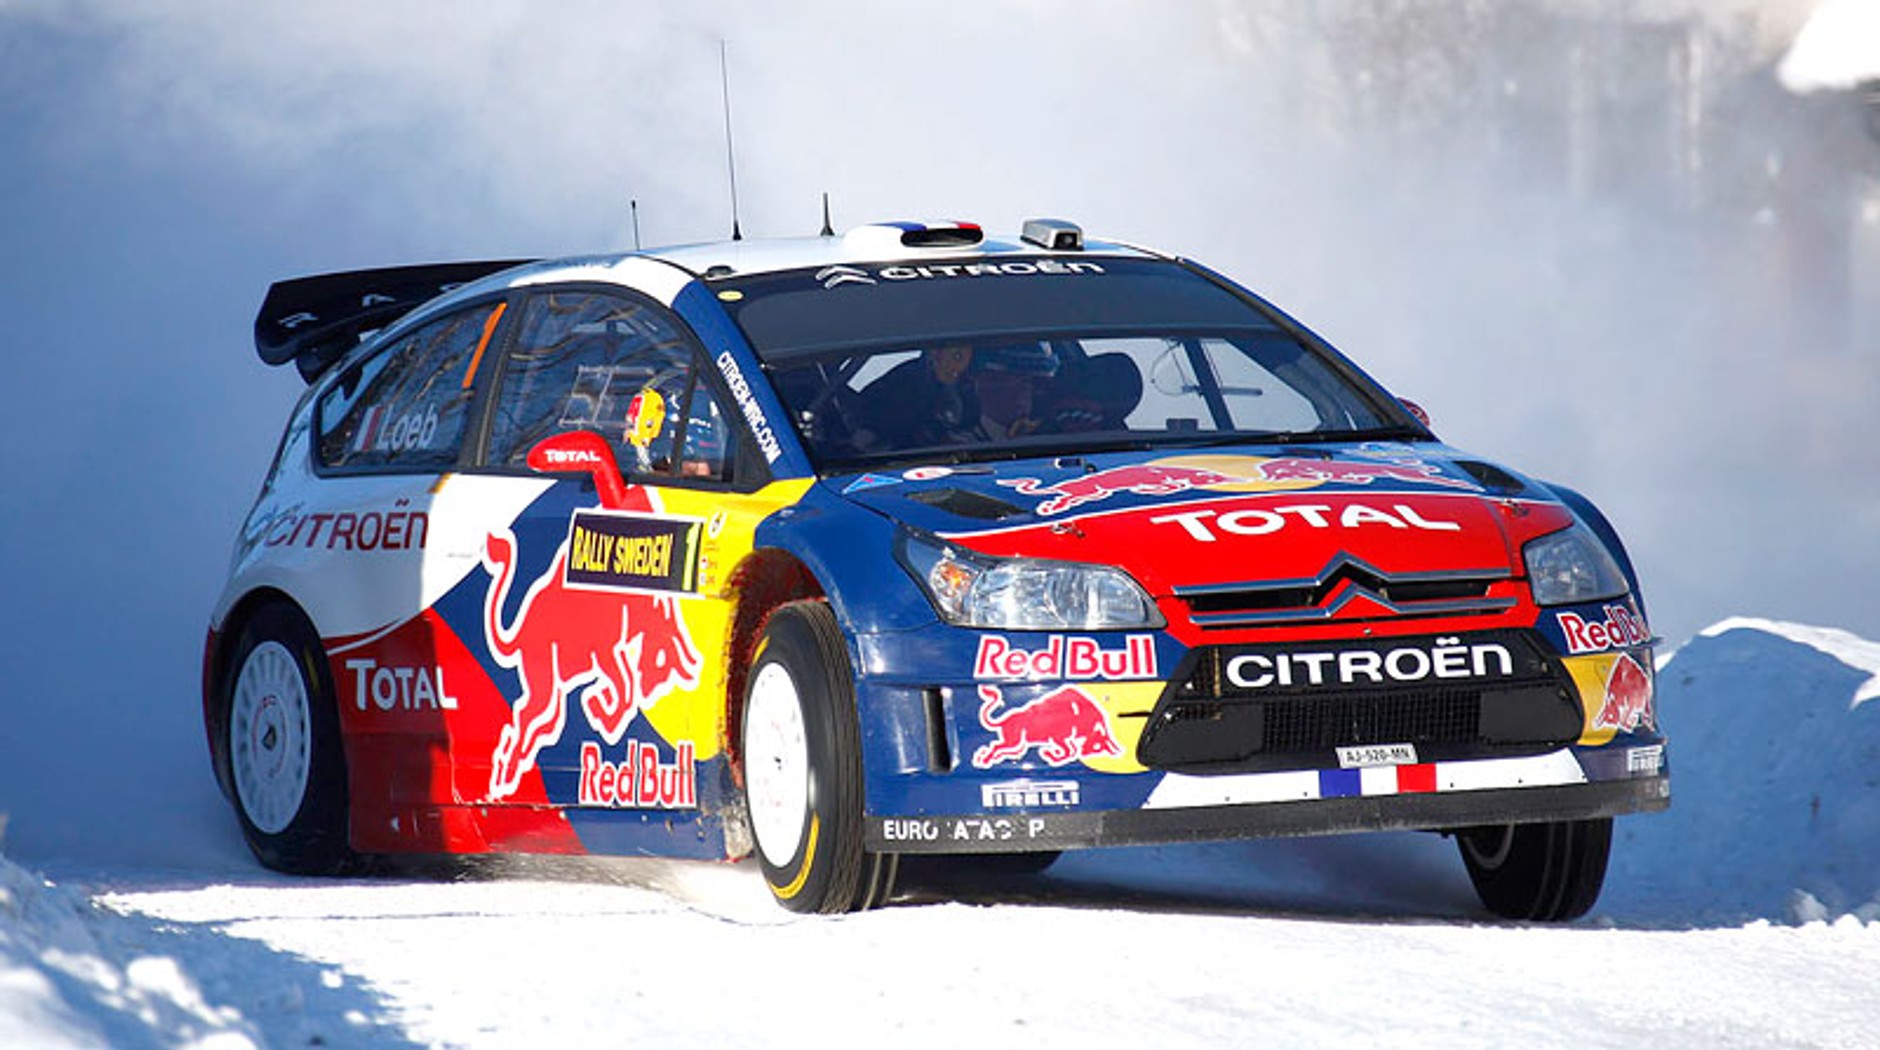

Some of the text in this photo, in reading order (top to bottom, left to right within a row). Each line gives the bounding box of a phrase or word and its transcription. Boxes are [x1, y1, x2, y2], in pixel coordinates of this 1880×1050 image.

[376, 403, 438, 450] Loeb
[545, 449, 601, 463] TOTAL
[1150, 504, 1461, 542] TOTAL
[571, 525, 615, 572] RALLY
[613, 533, 674, 578] SWEDEN
[681, 521, 700, 592] 1
[1556, 604, 1628, 653] Red
[974, 635, 1157, 679] Red Bull
[345, 658, 459, 711] TOTAL
[579, 740, 696, 808] Red Bull
[981, 778, 1080, 807] PIRELLI
